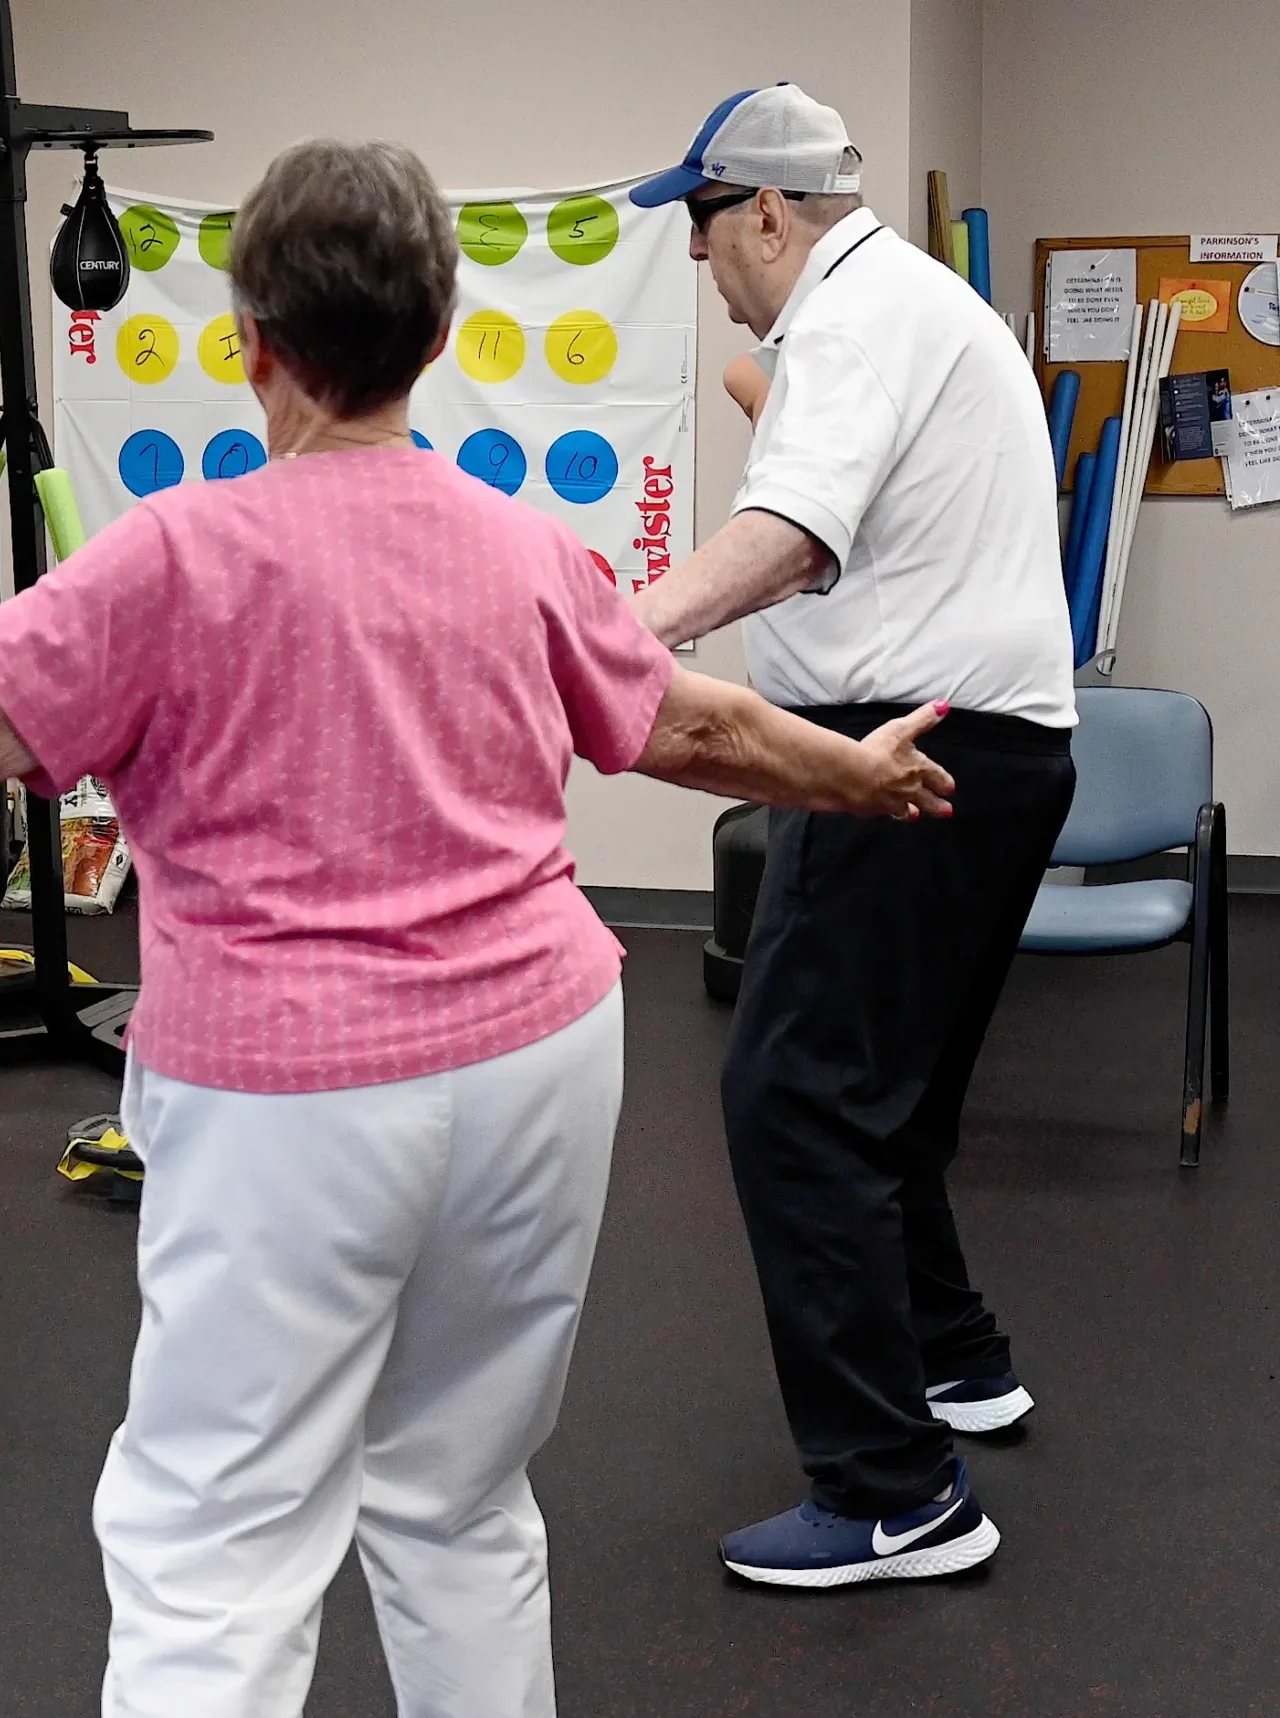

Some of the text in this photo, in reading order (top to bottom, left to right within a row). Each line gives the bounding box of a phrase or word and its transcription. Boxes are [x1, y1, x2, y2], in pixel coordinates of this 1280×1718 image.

[129, 223, 164, 256] 12
[568, 215, 599, 238] 5
[1200, 237, 1259, 245] PARKINSON'S
[80, 261, 121, 271] CENTURY
[1200, 252, 1263, 260] INFORMATION
[135, 328, 165, 367] 2
[478, 330, 501, 361] 11
[566, 329, 586, 366] 6
[489, 443, 509, 487] 9
[565, 451, 598, 480] 10
[632, 456, 674, 594] wister
